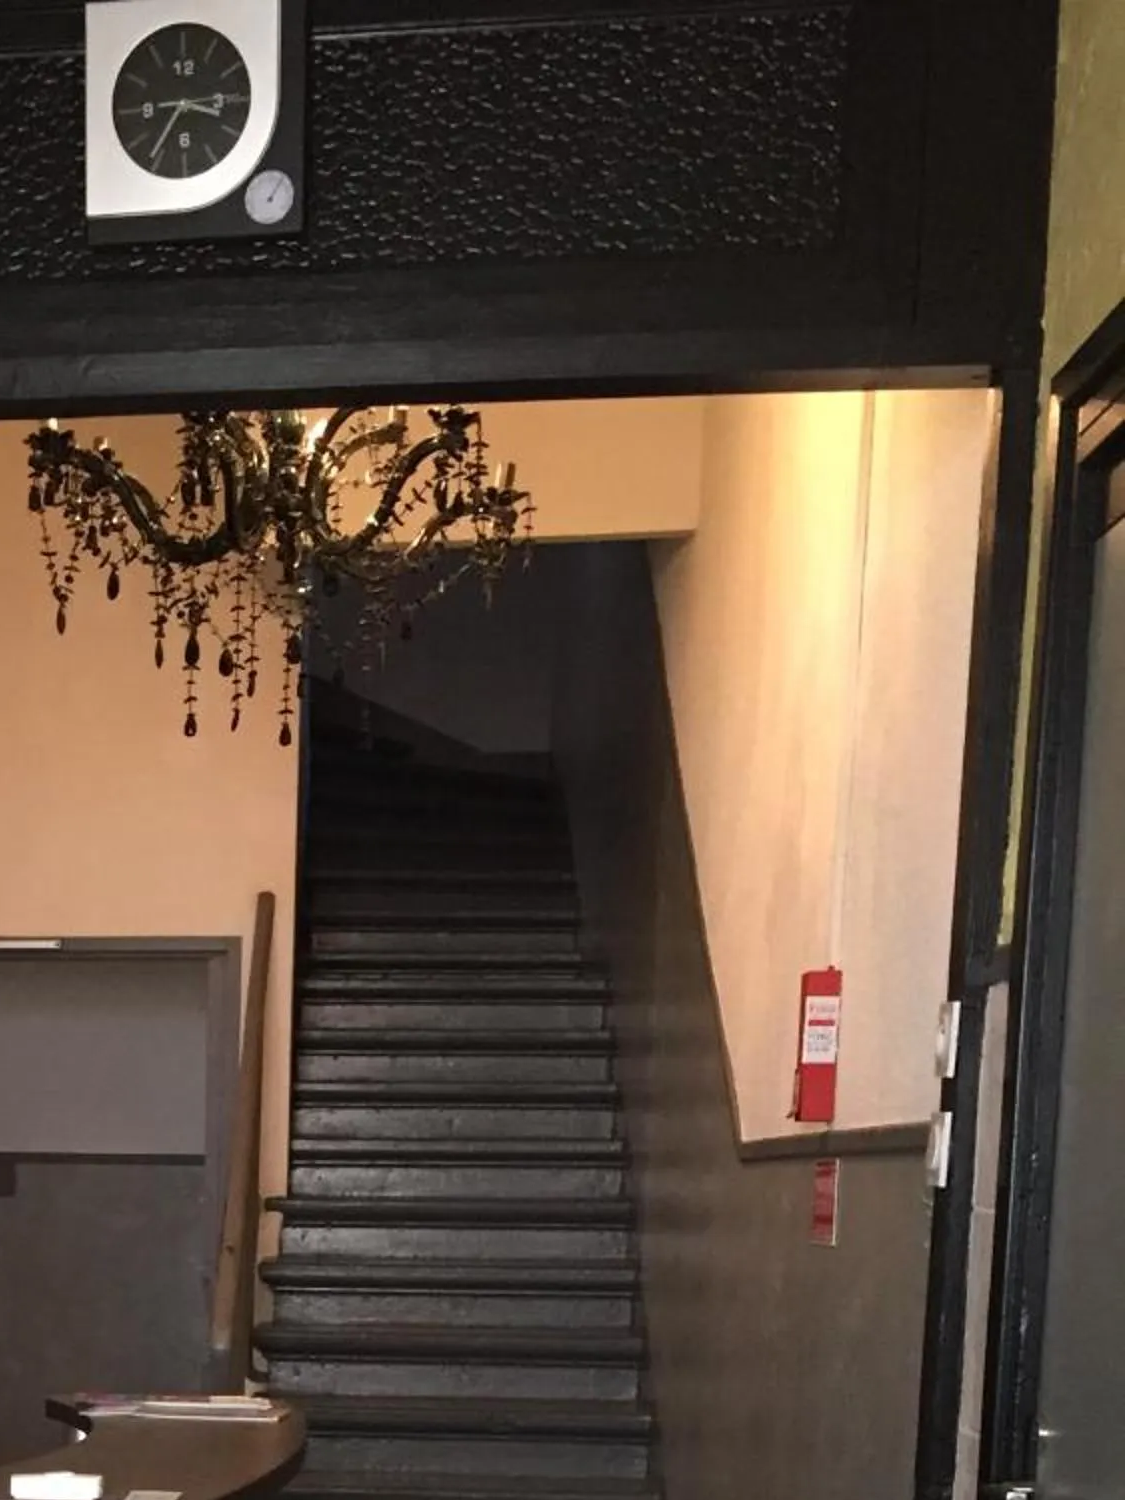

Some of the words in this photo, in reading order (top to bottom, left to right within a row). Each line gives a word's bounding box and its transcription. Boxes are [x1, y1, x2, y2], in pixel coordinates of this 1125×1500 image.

[173, 60, 195, 76] 12
[213, 93, 224, 109] 3
[142, 102, 154, 118] 9
